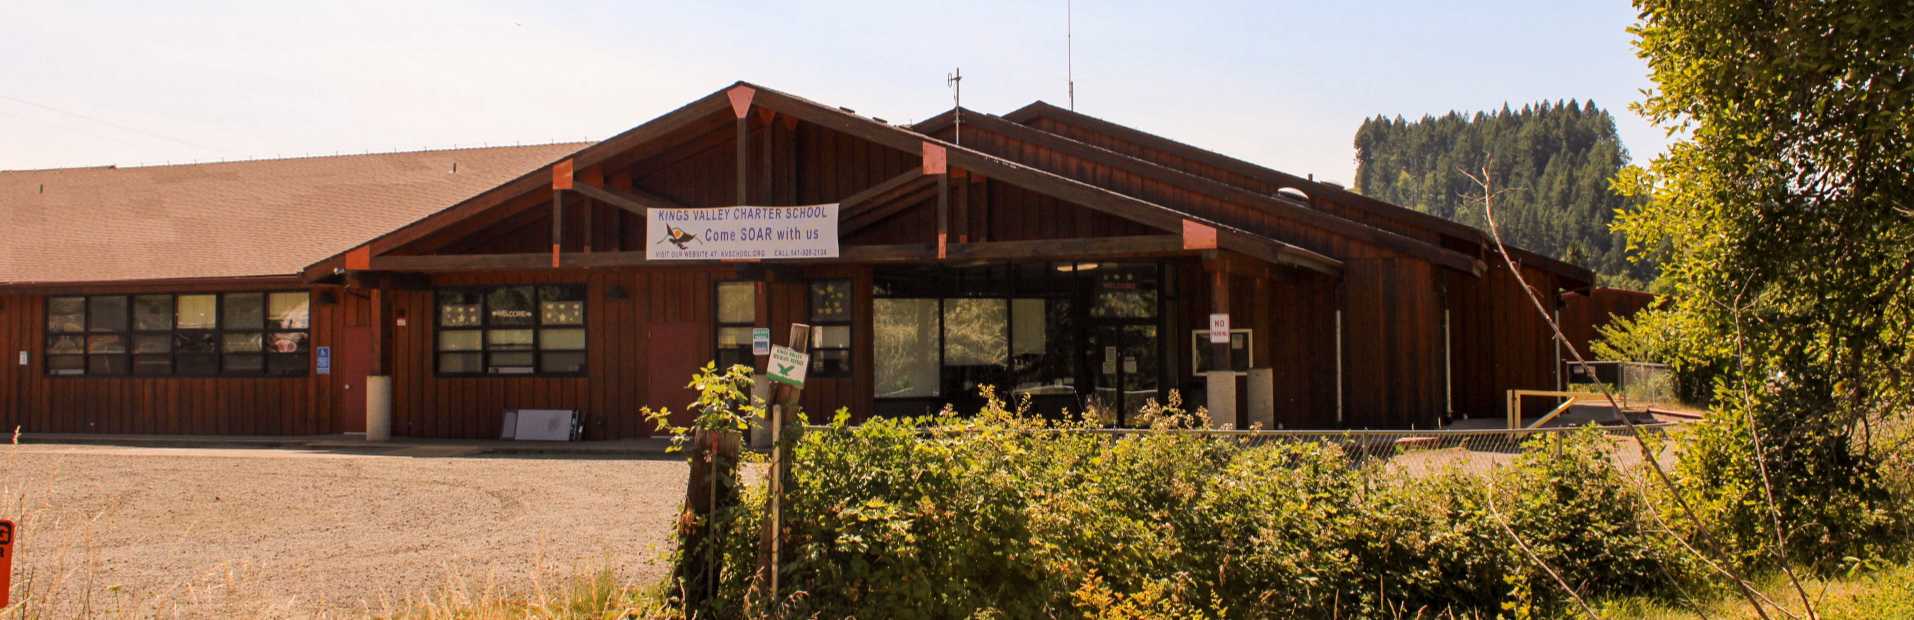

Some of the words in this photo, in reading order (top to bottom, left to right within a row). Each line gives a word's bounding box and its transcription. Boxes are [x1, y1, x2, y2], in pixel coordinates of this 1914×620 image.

[658, 209, 689, 221] KINGS
[693, 208, 730, 221] VALLEY
[733, 207, 782, 220] CHARTER
[785, 206, 828, 219] SCHOOL
[705, 228, 736, 241] Come
[740, 227, 772, 241] SOAR
[777, 226, 801, 241] with
[806, 228, 819, 240] us
[655, 250, 669, 258] VISIT
[671, 250, 682, 258] OUR
[684, 250, 708, 258] WEBSITE
